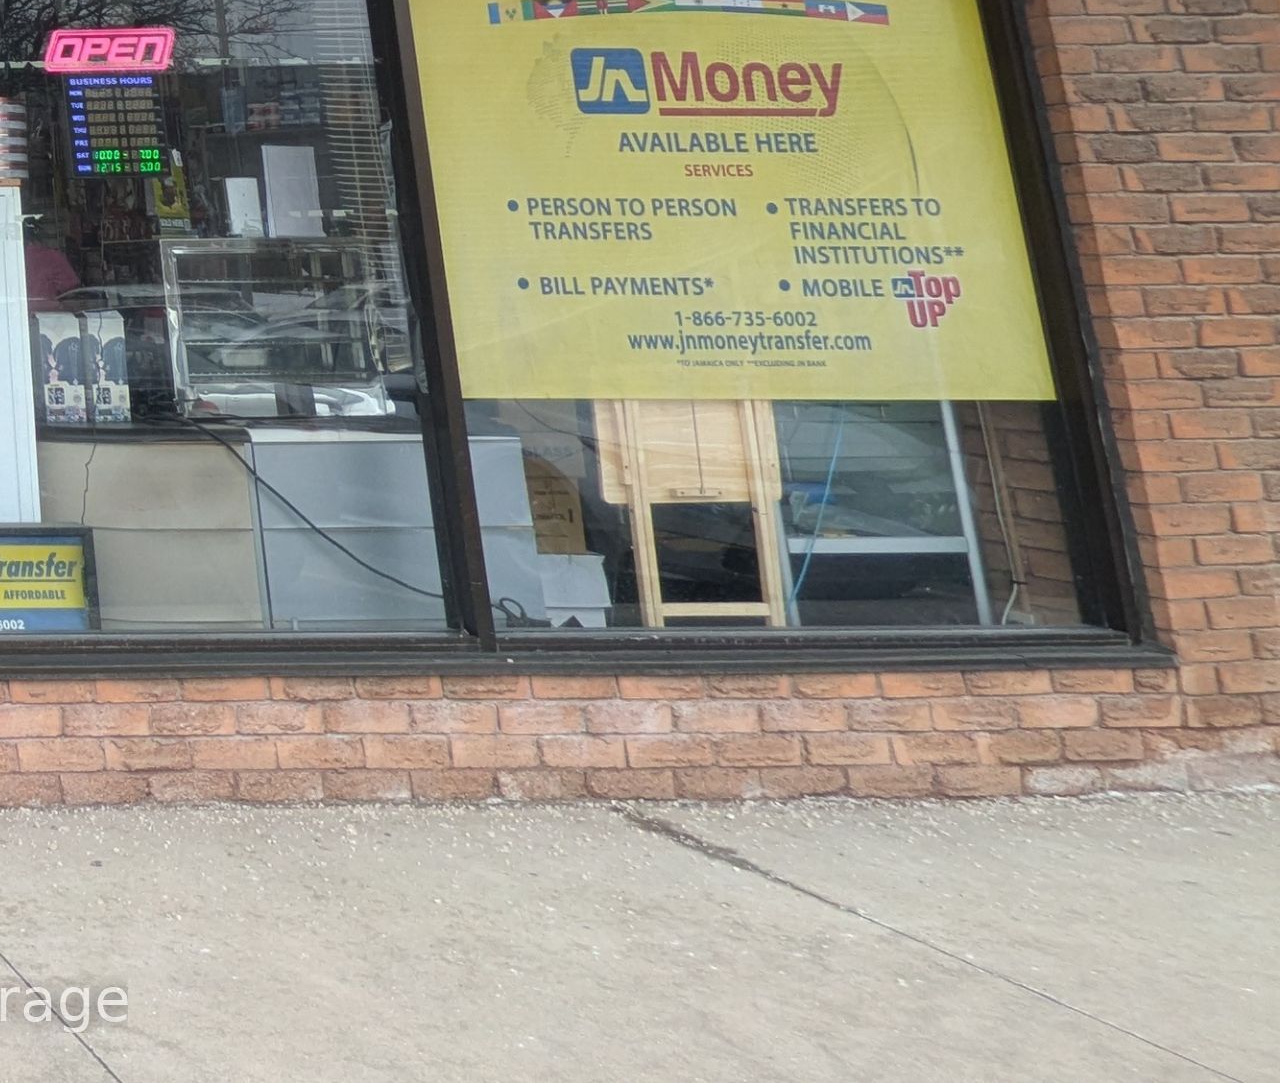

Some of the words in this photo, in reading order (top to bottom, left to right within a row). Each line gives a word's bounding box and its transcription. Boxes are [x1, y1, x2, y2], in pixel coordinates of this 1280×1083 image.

[52, 36, 167, 65] OPEN
[69, 78, 118, 86] BUSINESS
[120, 77, 153, 85] HOURS
[651, 50, 843, 118] Money
[618, 132, 750, 154] AVAILABLE
[755, 132, 818, 154] HERE
[684, 164, 754, 178] SERVICES
[527, 198, 612, 217] PERSON
[619, 198, 646, 217] TO
[652, 198, 738, 217] PERSON
[785, 197, 909, 217] TRANSFERS
[912, 198, 942, 217] TO
[529, 221, 653, 241] TRANSFERS
[790, 222, 907, 241] FINANCIAL
[540, 277, 585, 296] BILL
[802, 278, 885, 298] MOBILE
[907, 270, 962, 304] Top
[674, 311, 818, 327] 1-866-735-6002
[907, 300, 947, 328] UP
[627, 330, 872, 355] www.jnmoneytransfer.com
[3, 589, 66, 600] AFFORDABLE
